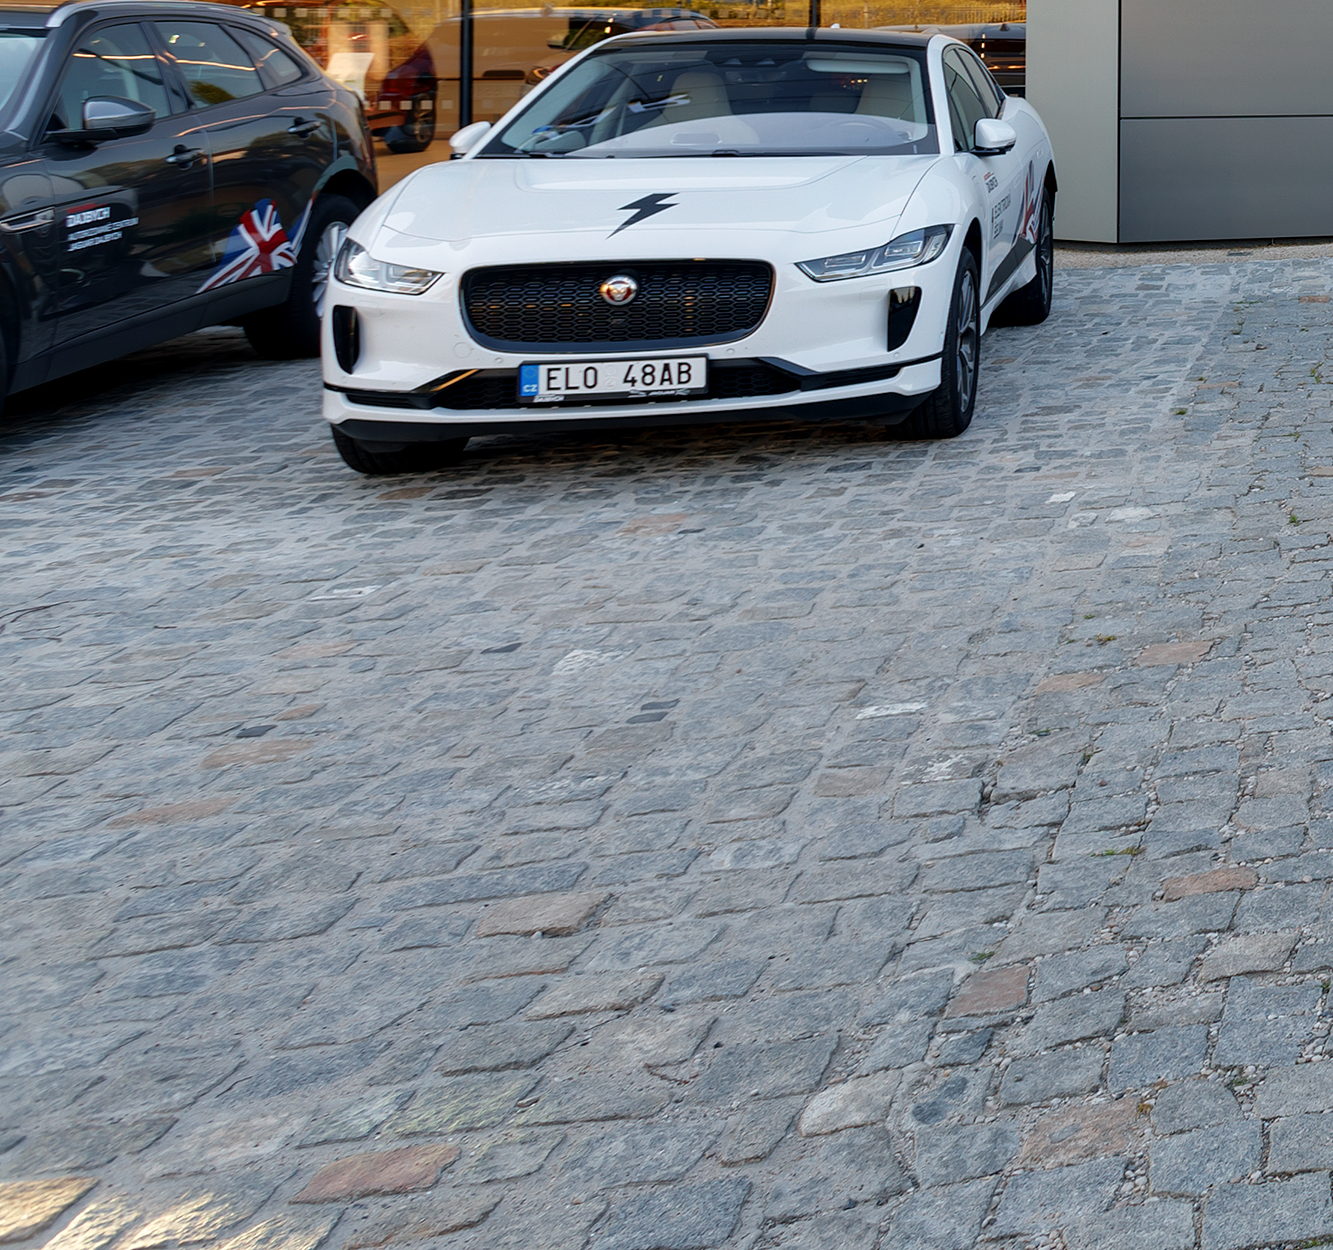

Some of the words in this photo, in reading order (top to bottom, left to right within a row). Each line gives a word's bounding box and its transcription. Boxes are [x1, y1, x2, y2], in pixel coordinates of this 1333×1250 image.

[66, 207, 111, 228] DAJBYCH
[623, 362, 692, 387] 48AB
[523, 384, 537, 393] CZ
